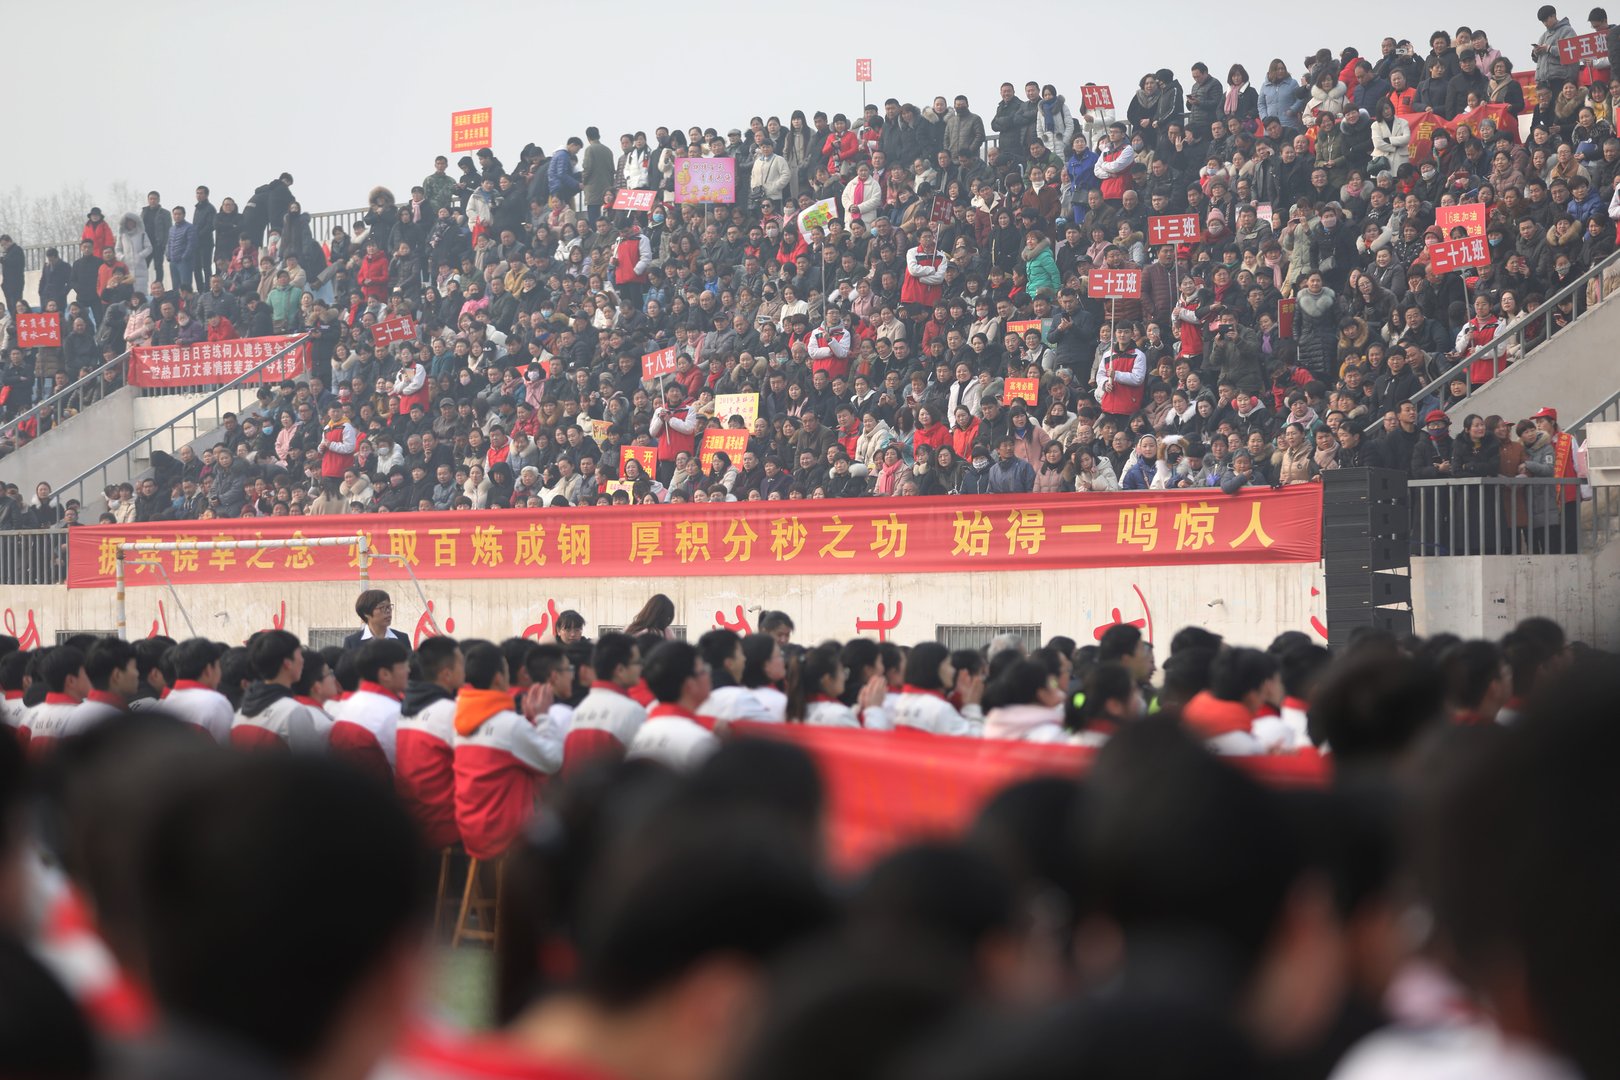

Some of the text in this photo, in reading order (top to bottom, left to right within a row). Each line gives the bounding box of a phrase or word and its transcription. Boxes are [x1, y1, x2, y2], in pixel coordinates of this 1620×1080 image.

[1563, 33, 1608, 60] 十五班
[1085, 88, 1111, 106] 十九班
[618, 191, 653, 207] 二十四班
[1445, 206, 1478, 224] 16班加油
[1153, 217, 1196, 240] 十三班
[1435, 239, 1486, 266] 二十九班
[1093, 272, 1137, 293] 二十五班
[376, 319, 412, 341] 二十一班
[645, 349, 674, 375] 十八班
[348, 523, 591, 568] 必取百炼成钢
[629, 513, 908, 564] 厚积分秒之功
[951, 502, 1275, 557] 始得一鸣惊人
